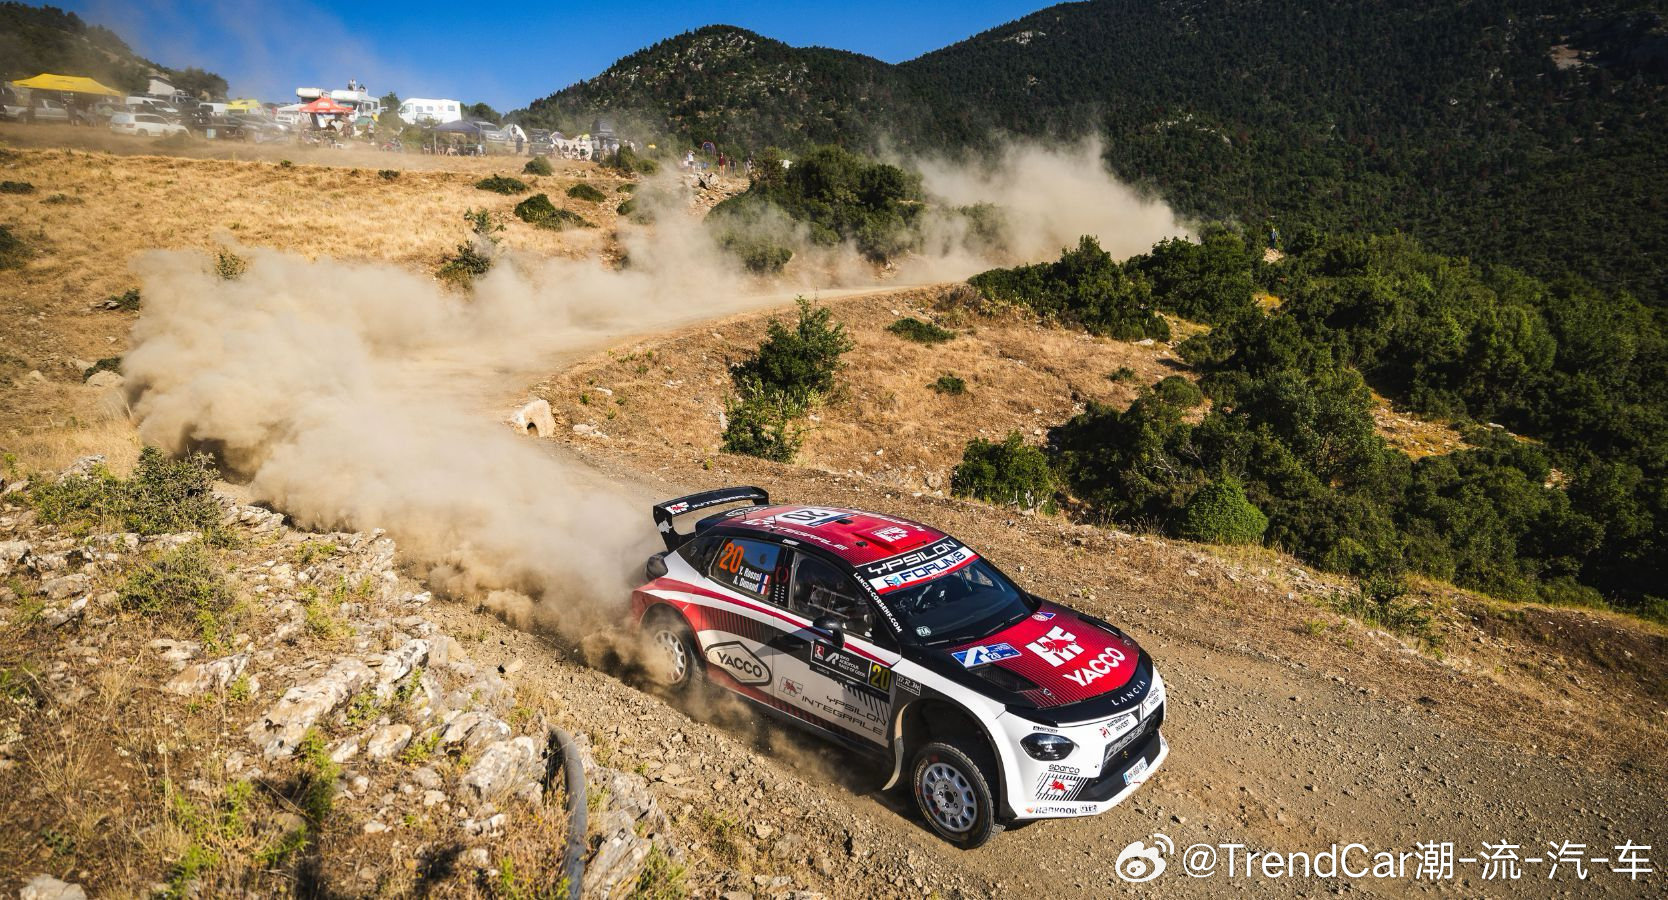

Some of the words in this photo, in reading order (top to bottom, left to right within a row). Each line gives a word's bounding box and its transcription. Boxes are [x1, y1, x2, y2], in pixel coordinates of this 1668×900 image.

[719, 542, 744, 574] 20
[867, 540, 957, 575] YPSILON
[899, 551, 966, 582] FORUM8
[717, 651, 763, 679] YACCO
[870, 664, 891, 690] 20
[1062, 647, 1126, 687] YACCO
[1111, 679, 1146, 706] LANCIA
[801, 695, 883, 735] INTEGRALE
[826, 695, 887, 727] YPSILON
